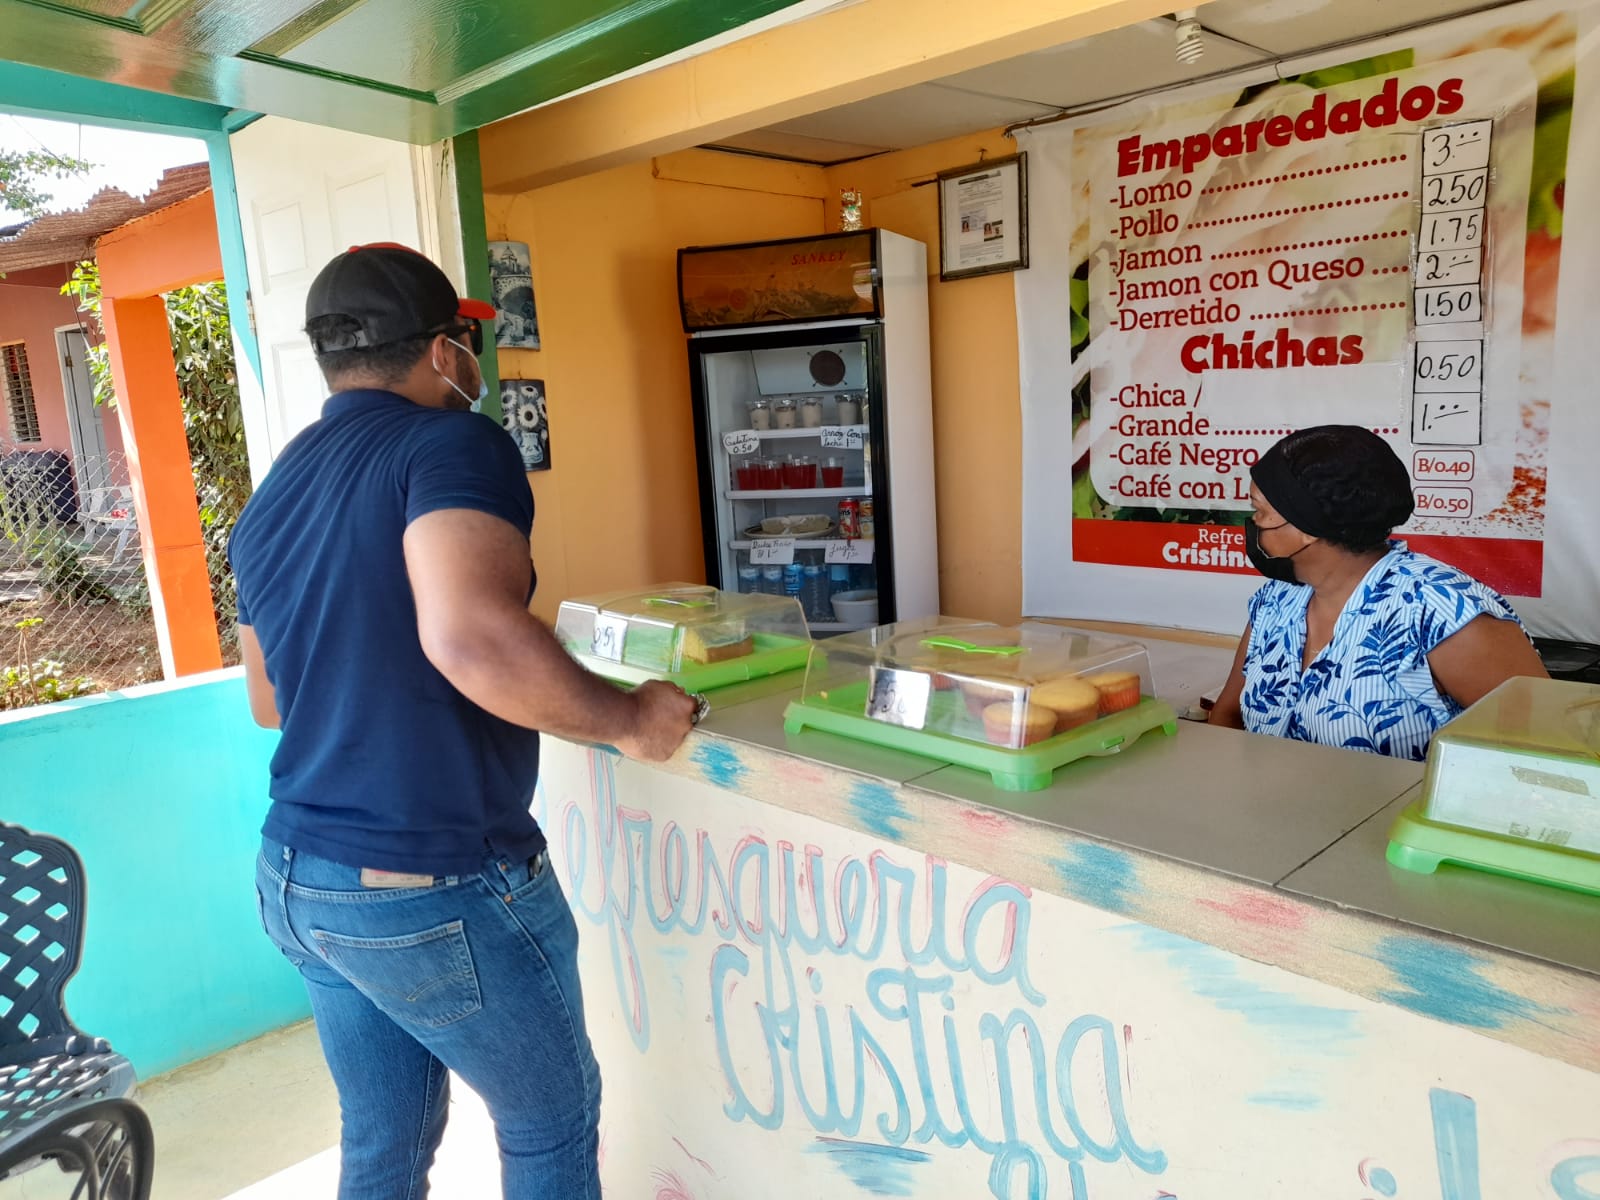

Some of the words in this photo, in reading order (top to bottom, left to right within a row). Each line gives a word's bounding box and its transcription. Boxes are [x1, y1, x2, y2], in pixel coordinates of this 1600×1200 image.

[1117, 77, 1464, 178] Emparedados
[1110, 179, 1192, 209] -Lomo
[1428, 174, 1485, 207] 2.50
[1110, 208, 1179, 239] -Pollo
[1430, 214, 1479, 245] 1.75
[791, 251, 847, 266] SANKEY
[1109, 243, 1203, 277] -Jamon
[1109, 273, 1201, 307] -Jamon
[1209, 269, 1259, 292] con
[1267, 256, 1365, 290] Queso
[1110, 297, 1241, 332] -Derretido
[1424, 291, 1473, 317] 1.50
[1180, 328, 1364, 374] Chichas
[1417, 354, 1476, 381] 0.50
[1110, 382, 1187, 408] -Chica
[1109, 411, 1210, 437] -Grande
[1109, 441, 1172, 466] -Café
[1179, 443, 1260, 474] Negro
[1417, 457, 1471, 476] B/0.40
[1109, 473, 1172, 499] -Café
[1179, 481, 1225, 499] con
[1416, 494, 1469, 513] B/0.50
[1198, 529, 1244, 545] Refre
